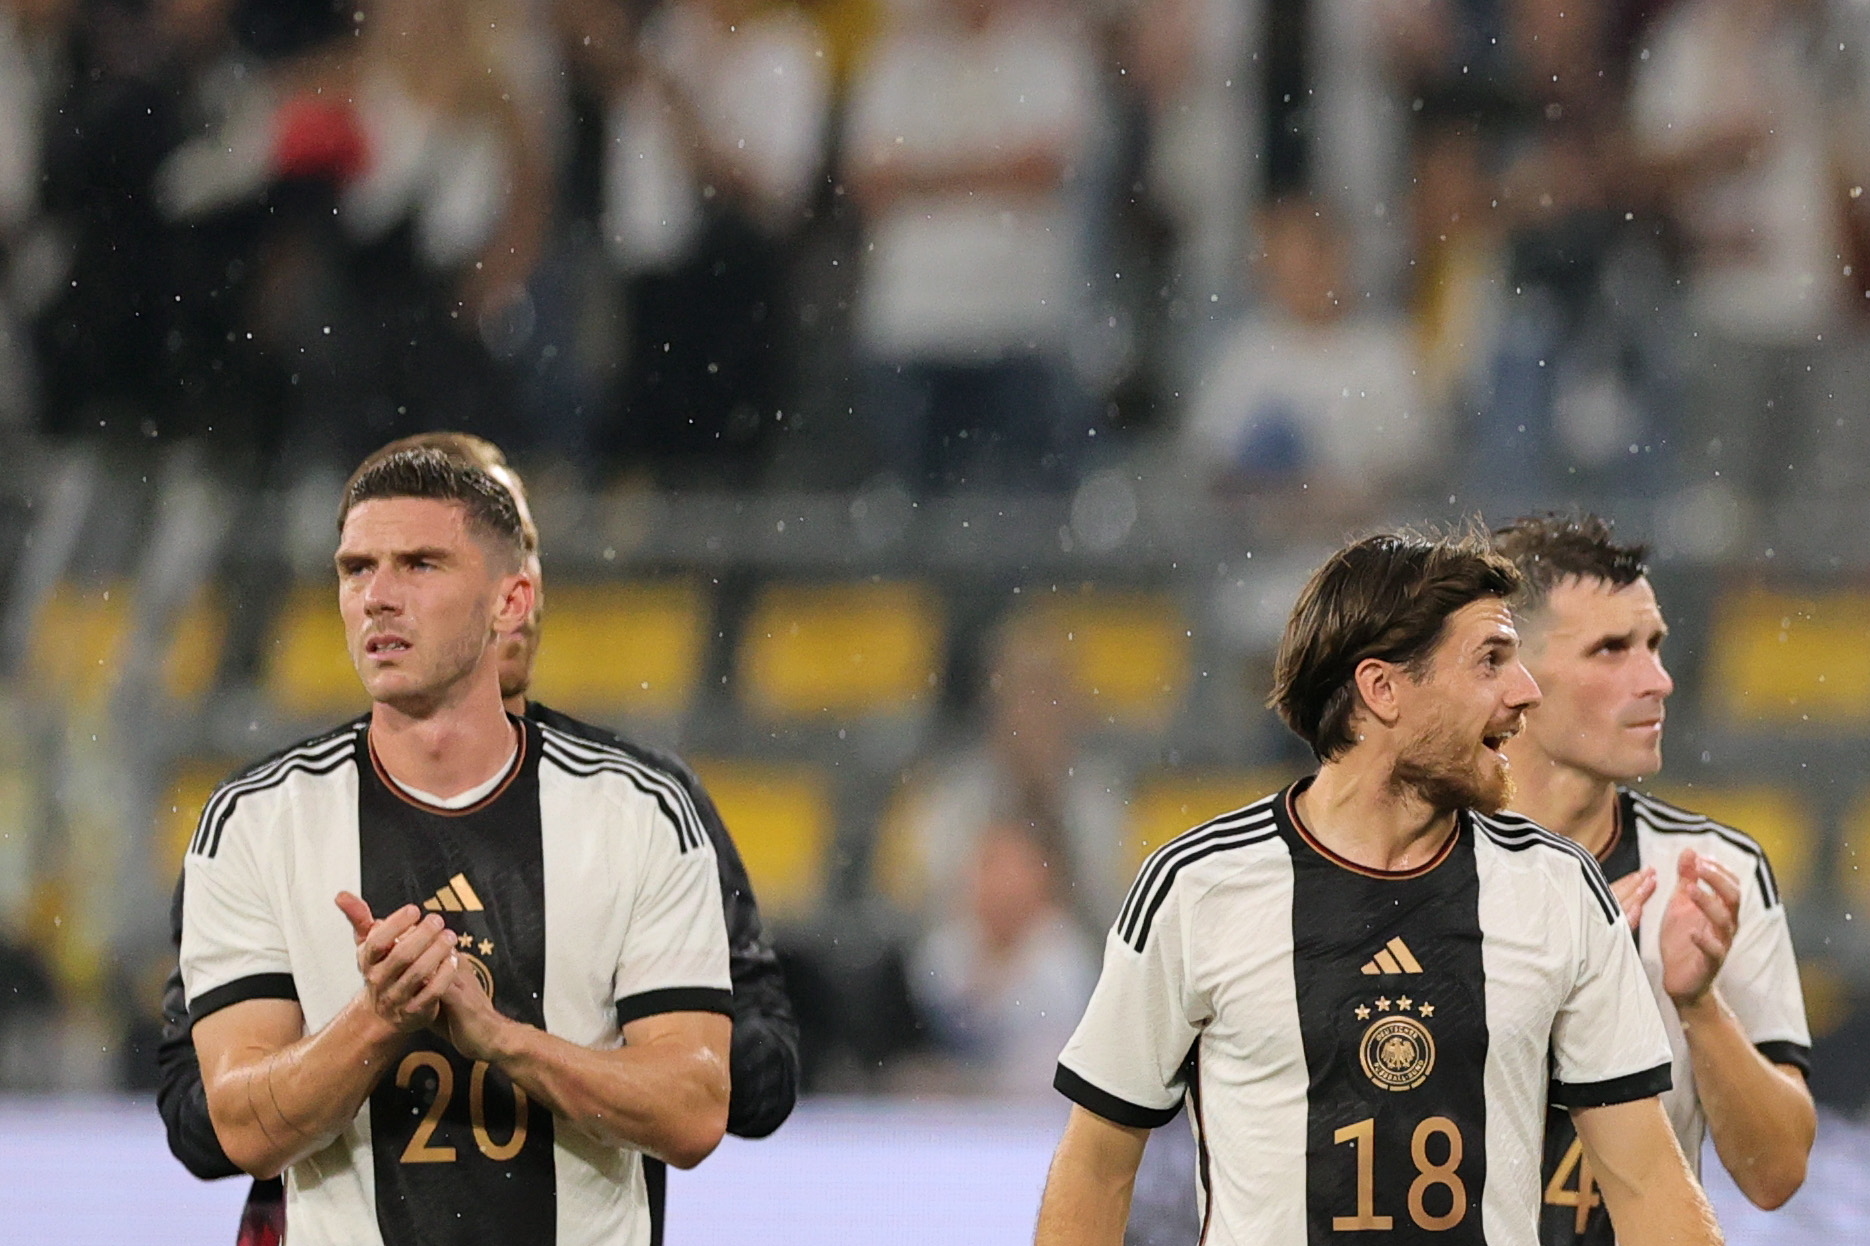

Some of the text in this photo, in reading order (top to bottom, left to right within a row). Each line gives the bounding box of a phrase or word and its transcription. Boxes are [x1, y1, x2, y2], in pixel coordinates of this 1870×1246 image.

[396, 1051, 528, 1163] 20
[1333, 1116, 1467, 1231] 18
[1544, 1136, 1601, 1235] 4
